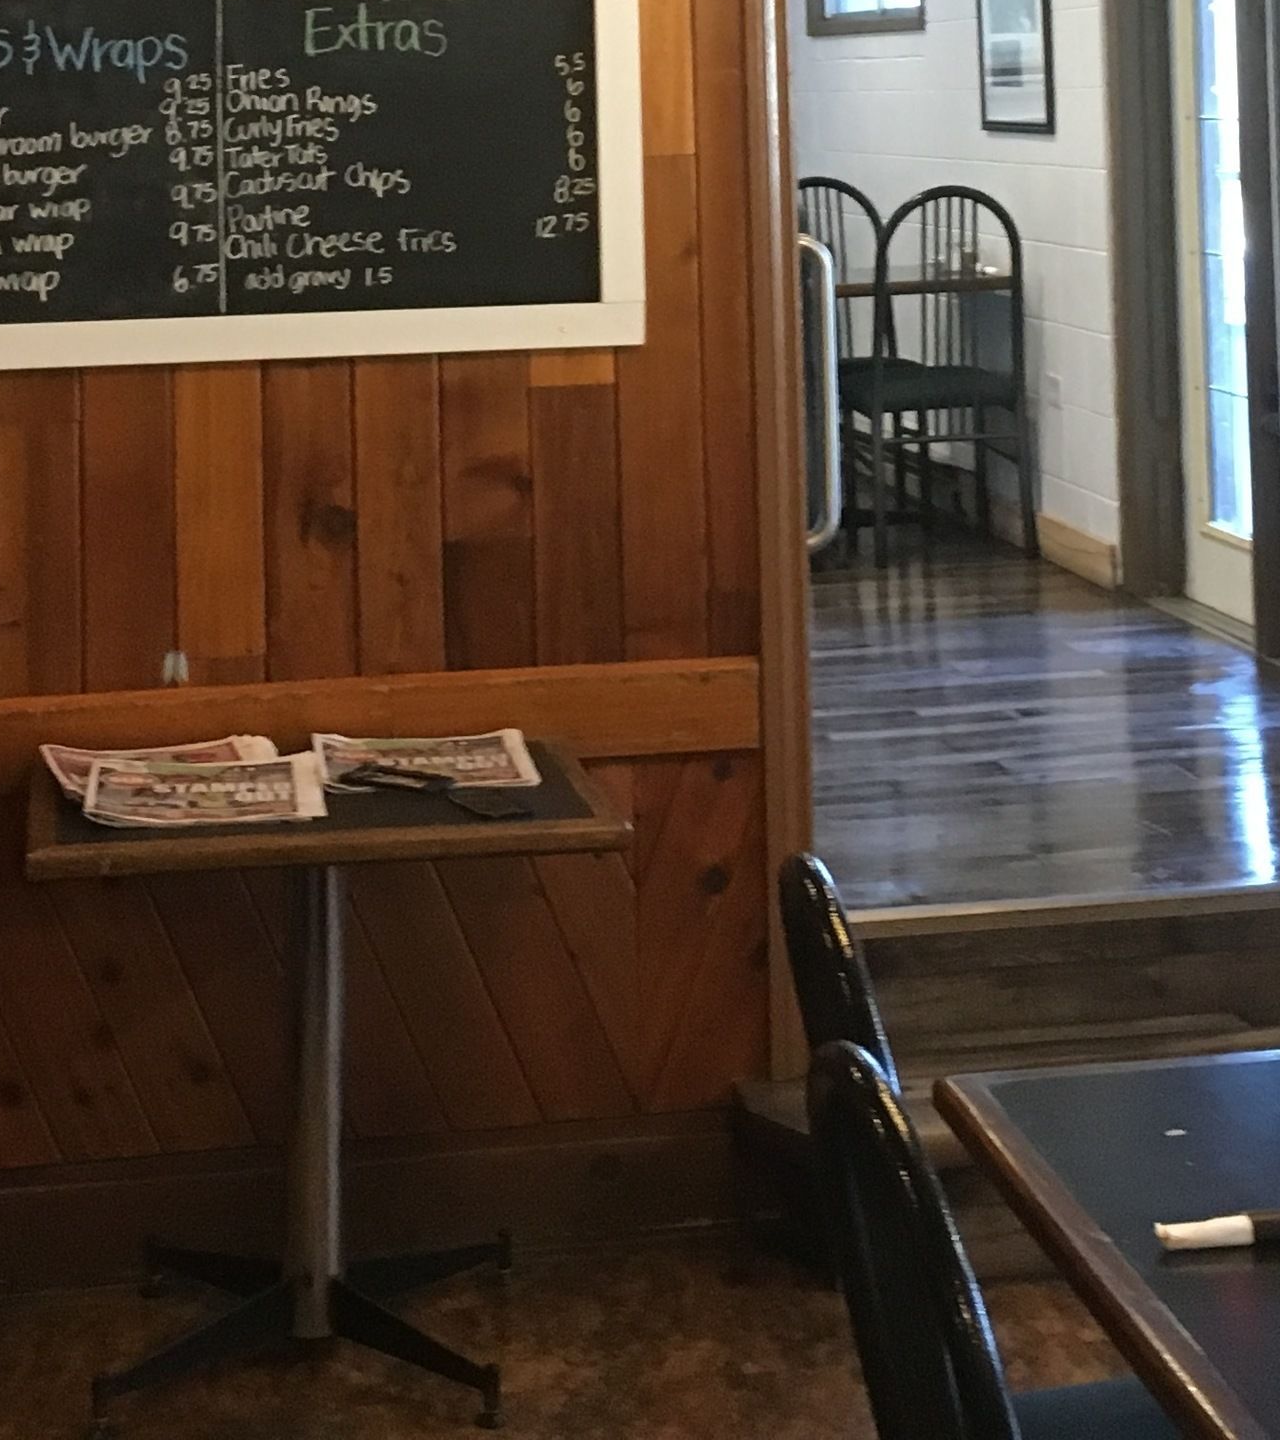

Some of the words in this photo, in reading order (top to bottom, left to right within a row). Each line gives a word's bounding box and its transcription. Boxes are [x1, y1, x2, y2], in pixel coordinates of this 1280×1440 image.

[304, 2, 448, 56] Extras
[20, 19, 42, 75] &
[45, 25, 189, 84] Wraps
[226, 65, 291, 93] Fries
[566, 77, 584, 95] 6
[226, 88, 298, 114] Onion
[305, 86, 378, 122] Rings
[564, 99, 582, 123] 6
[70, 122, 154, 157] burger
[225, 119, 282, 145] Curly
[286, 114, 339, 142] Fries
[566, 126, 584, 147] 6
[225, 146, 280, 168] Tater
[288, 143, 329, 164] Tots
[568, 148, 585, 172] 6
[2, 163, 87, 197] burger
[344, 162, 412, 198] Chips
[286, 229, 385, 259] Cheese
[244, 264, 284, 289] add
[288, 268, 351, 294] gravy
